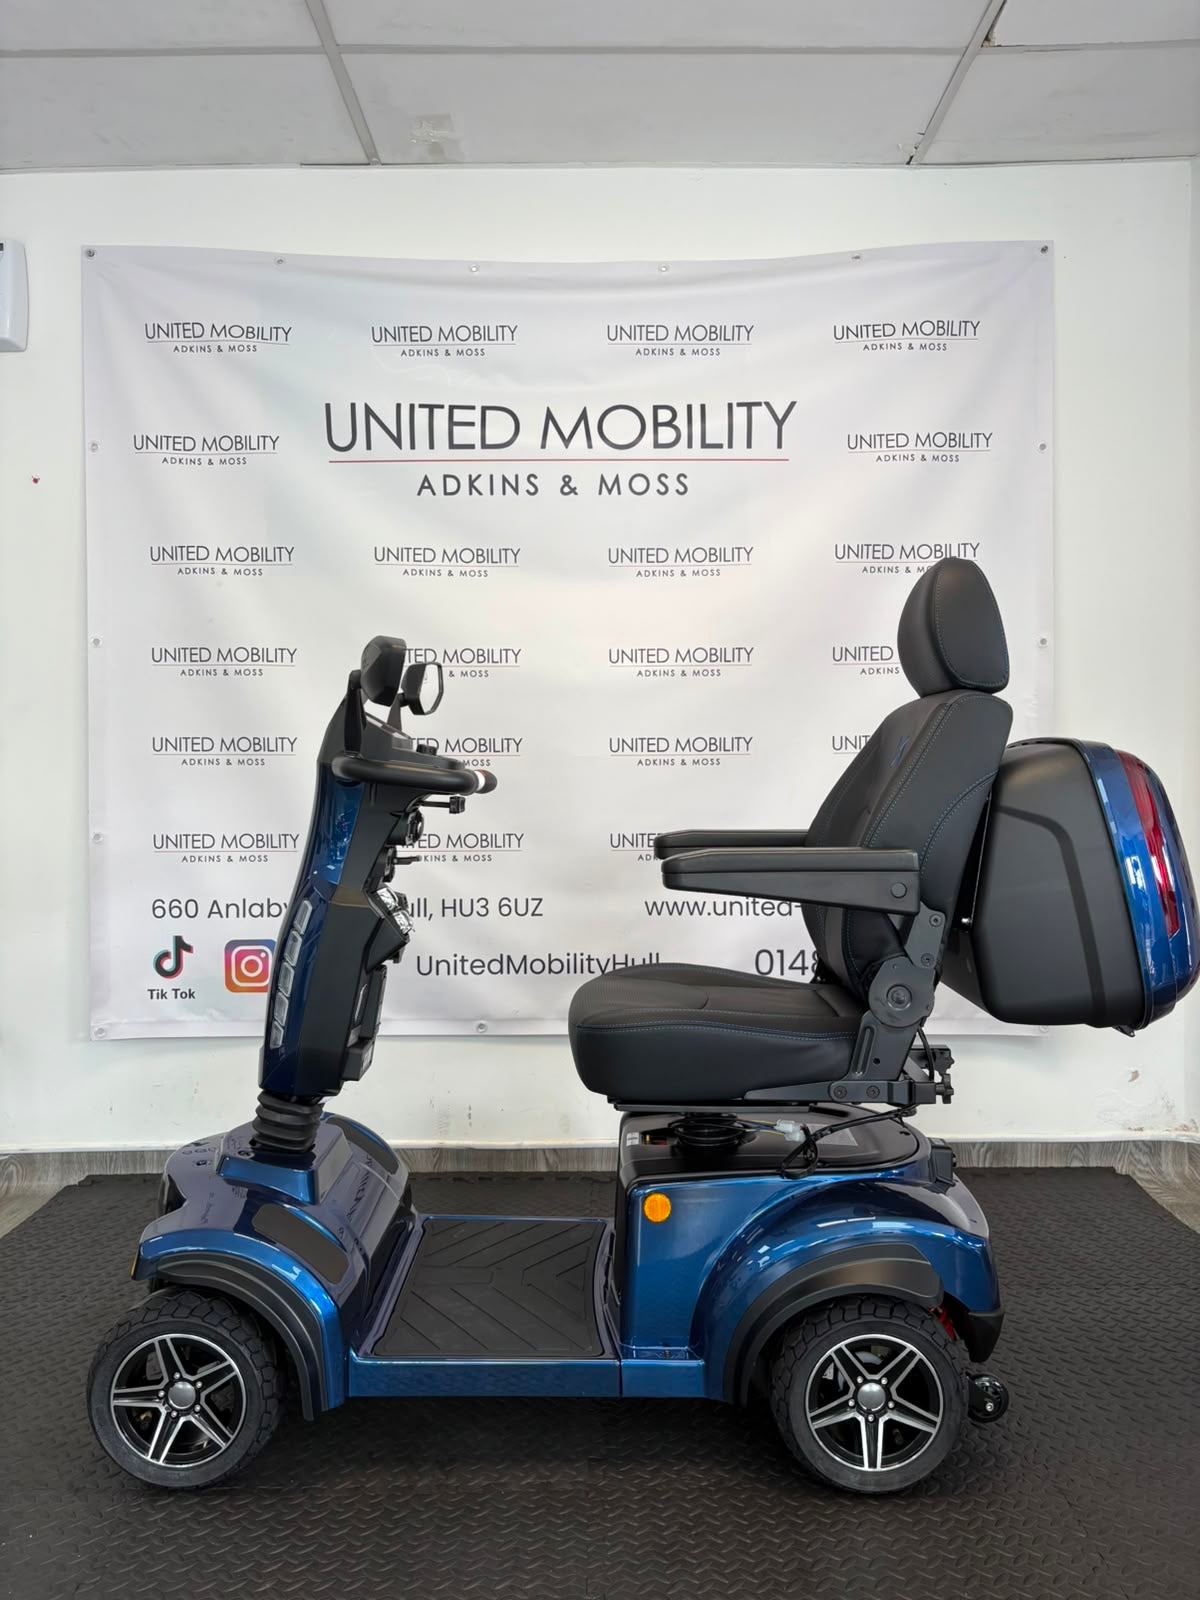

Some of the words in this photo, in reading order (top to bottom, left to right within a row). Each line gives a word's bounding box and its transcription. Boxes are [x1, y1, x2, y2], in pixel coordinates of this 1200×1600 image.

[144, 321, 205, 340] UNITED
[209, 324, 293, 343] MOBILITY
[371, 325, 433, 344] UNITED
[437, 324, 519, 343] MOBILITY
[606, 324, 670, 342] UNITED
[674, 324, 755, 342] MOBILITY
[833, 322, 897, 341] UNITED
[901, 319, 981, 337] MOBILITY
[172, 344, 213, 354] ADKINS
[216, 344, 224, 353] &
[227, 344, 257, 353] MOSS
[400, 348, 440, 358] ADKINS
[444, 348, 452, 357] &
[456, 347, 486, 357] MOSS
[635, 347, 675, 357] ADKINS
[679, 348, 687, 357] &
[691, 347, 721, 357] MOSS
[862, 342, 903, 351] ADKINS
[907, 342, 915, 351] &
[919, 342, 947, 352] MOSS
[324, 401, 521, 453] UNITED
[540, 400, 798, 451] MOBILITY
[133, 433, 197, 452] UNITED
[201, 434, 280, 452] MOBILITY
[847, 432, 910, 451] UNITED
[914, 431, 993, 449] MOBILITY
[161, 456, 203, 466] ADKINS
[207, 458, 215, 466] &
[218, 456, 247, 466] MOSS
[875, 453, 916, 463] ADKINS
[920, 453, 927, 462] &
[931, 454, 960, 463] MOSS
[416, 473, 539, 497] ADKINS
[559, 474, 579, 497] &
[597, 472, 689, 497] MOSS
[149, 545, 210, 565] UNITED
[214, 547, 295, 564] MOBILITY
[373, 546, 434, 564] UNITED
[441, 547, 521, 565] MOBILITY
[608, 547, 670, 565] UNITED
[674, 546, 754, 564] MOBILITY
[834, 543, 895, 561] UNITED
[899, 542, 981, 559] MOBILITY
[177, 567, 216, 575] ADKINS
[220, 567, 228, 576] &
[233, 567, 263, 577] MOSS
[402, 568, 442, 577] ADKINS
[447, 569, 454, 577] &
[459, 569, 489, 578] MOSS
[635, 569, 675, 578] ADKINS
[679, 569, 687, 578] &
[691, 568, 721, 577] MOSS
[861, 565, 900, 574] ADKINS
[904, 565, 912, 574] &
[151, 646, 212, 664] UNITED
[216, 646, 298, 664] MOBILITY
[405, 647, 438, 664] TED
[442, 647, 522, 665] MOBILITY
[608, 647, 670, 665] UNITED
[674, 646, 755, 664] MOBILITY
[832, 645, 894, 663] UNITED
[179, 668, 218, 677] ADKINS
[222, 668, 229, 677] &
[234, 668, 264, 677] MOSS
[448, 670, 456, 678] &
[460, 669, 489, 678] MOSS
[636, 668, 676, 678] ADKINS
[680, 669, 688, 678] &
[692, 668, 721, 678] MOSS
[859, 666, 900, 675] ADKINS
[152, 736, 215, 753] UNITED
[219, 736, 298, 753] MOBILITY
[444, 737, 523, 754] MOBILITY
[609, 737, 670, 754] UNITED
[674, 736, 754, 753] MOBILITY
[831, 735, 871, 751] UNIT
[181, 757, 221, 766] ADKINS
[225, 758, 233, 766] &
[237, 758, 266, 766] MOSS
[462, 758, 491, 767] MOSS
[636, 758, 676, 767] ADKINS
[680, 758, 687, 767] &
[691, 757, 721, 766] MOSS
[152, 833, 216, 850] UNITED
[220, 832, 300, 850] MOBILITY
[445, 832, 525, 849] MOBILITY
[609, 832, 657, 849] UNITE
[181, 854, 222, 863] ADKINS
[226, 855, 234, 863] &
[238, 854, 269, 863] MOSS
[423, 854, 447, 863] KINS
[451, 854, 459, 863] &
[463, 854, 493, 862] MOSS
[151, 898, 199, 920] 660
[207, 898, 288, 920] Anlab
[441, 897, 490, 918] HU3
[497, 896, 544, 918] 6UZ
[147, 988, 168, 1001] Tik
[171, 987, 196, 1000] Tok
